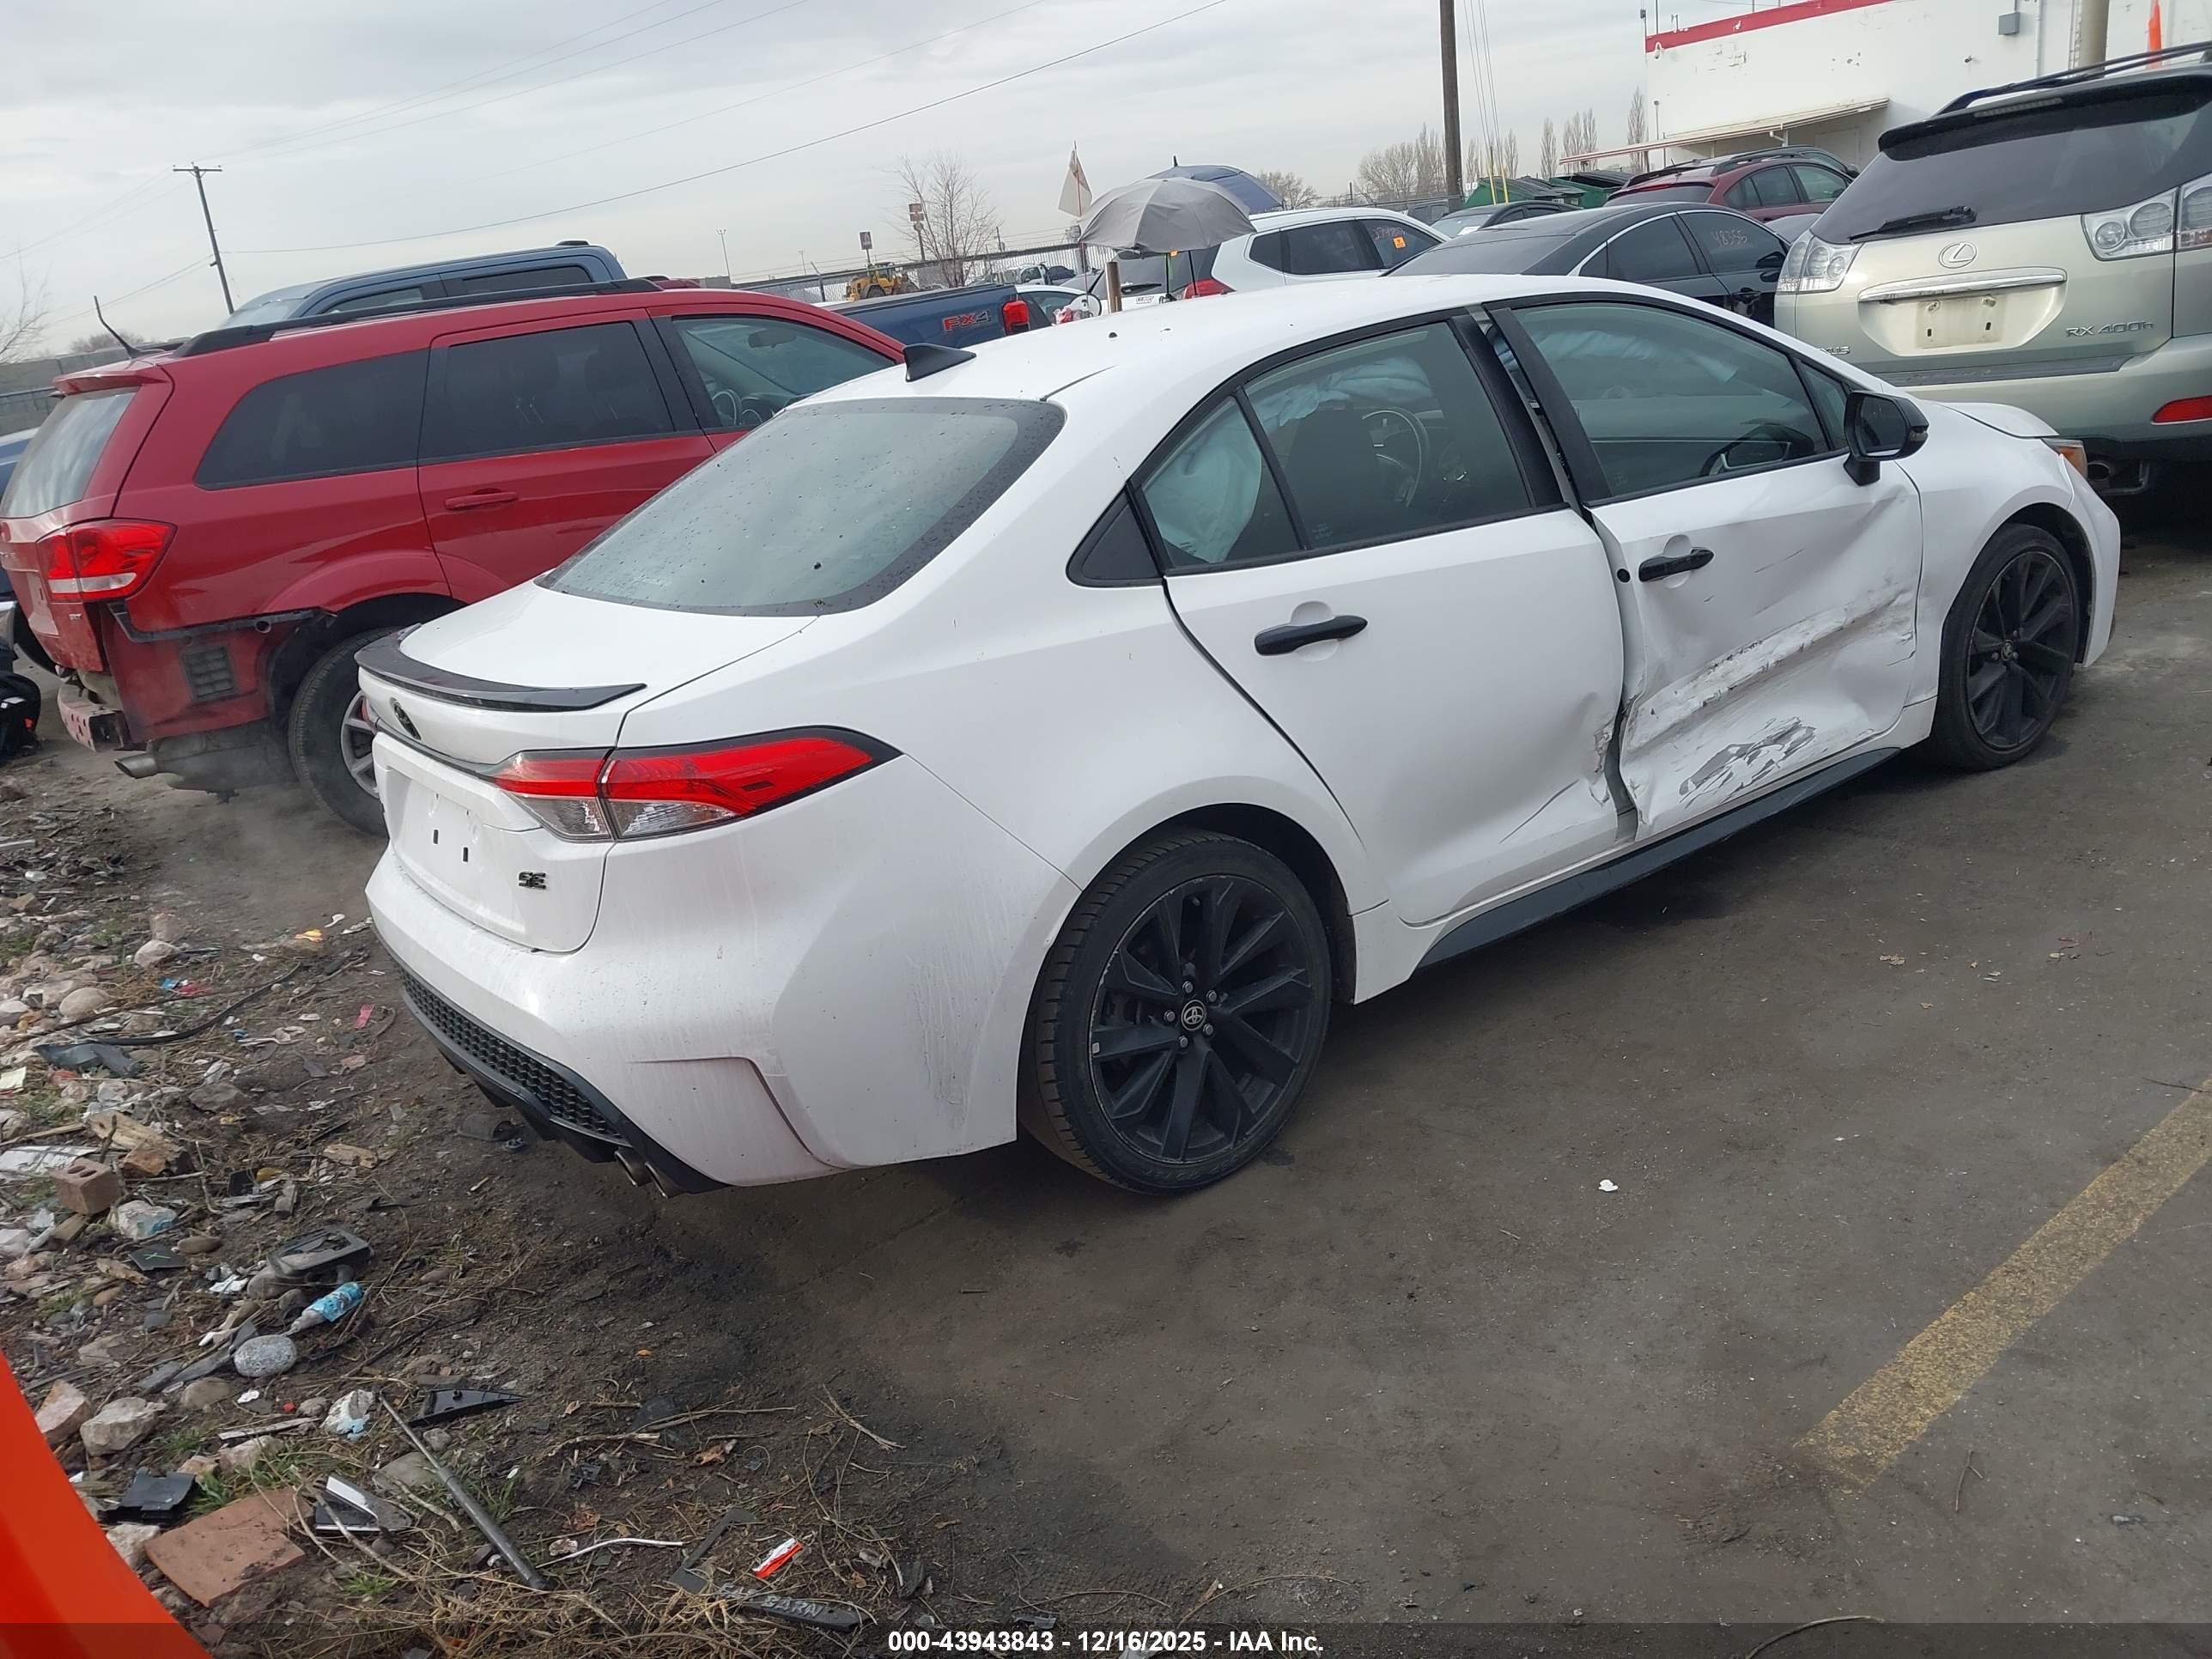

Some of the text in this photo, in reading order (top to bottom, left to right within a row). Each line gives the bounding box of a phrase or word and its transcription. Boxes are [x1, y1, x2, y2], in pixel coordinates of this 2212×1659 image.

[943, 309, 991, 332] FX4
[2065, 320, 2154, 337] RX 400h
[518, 871, 547, 890] SE
